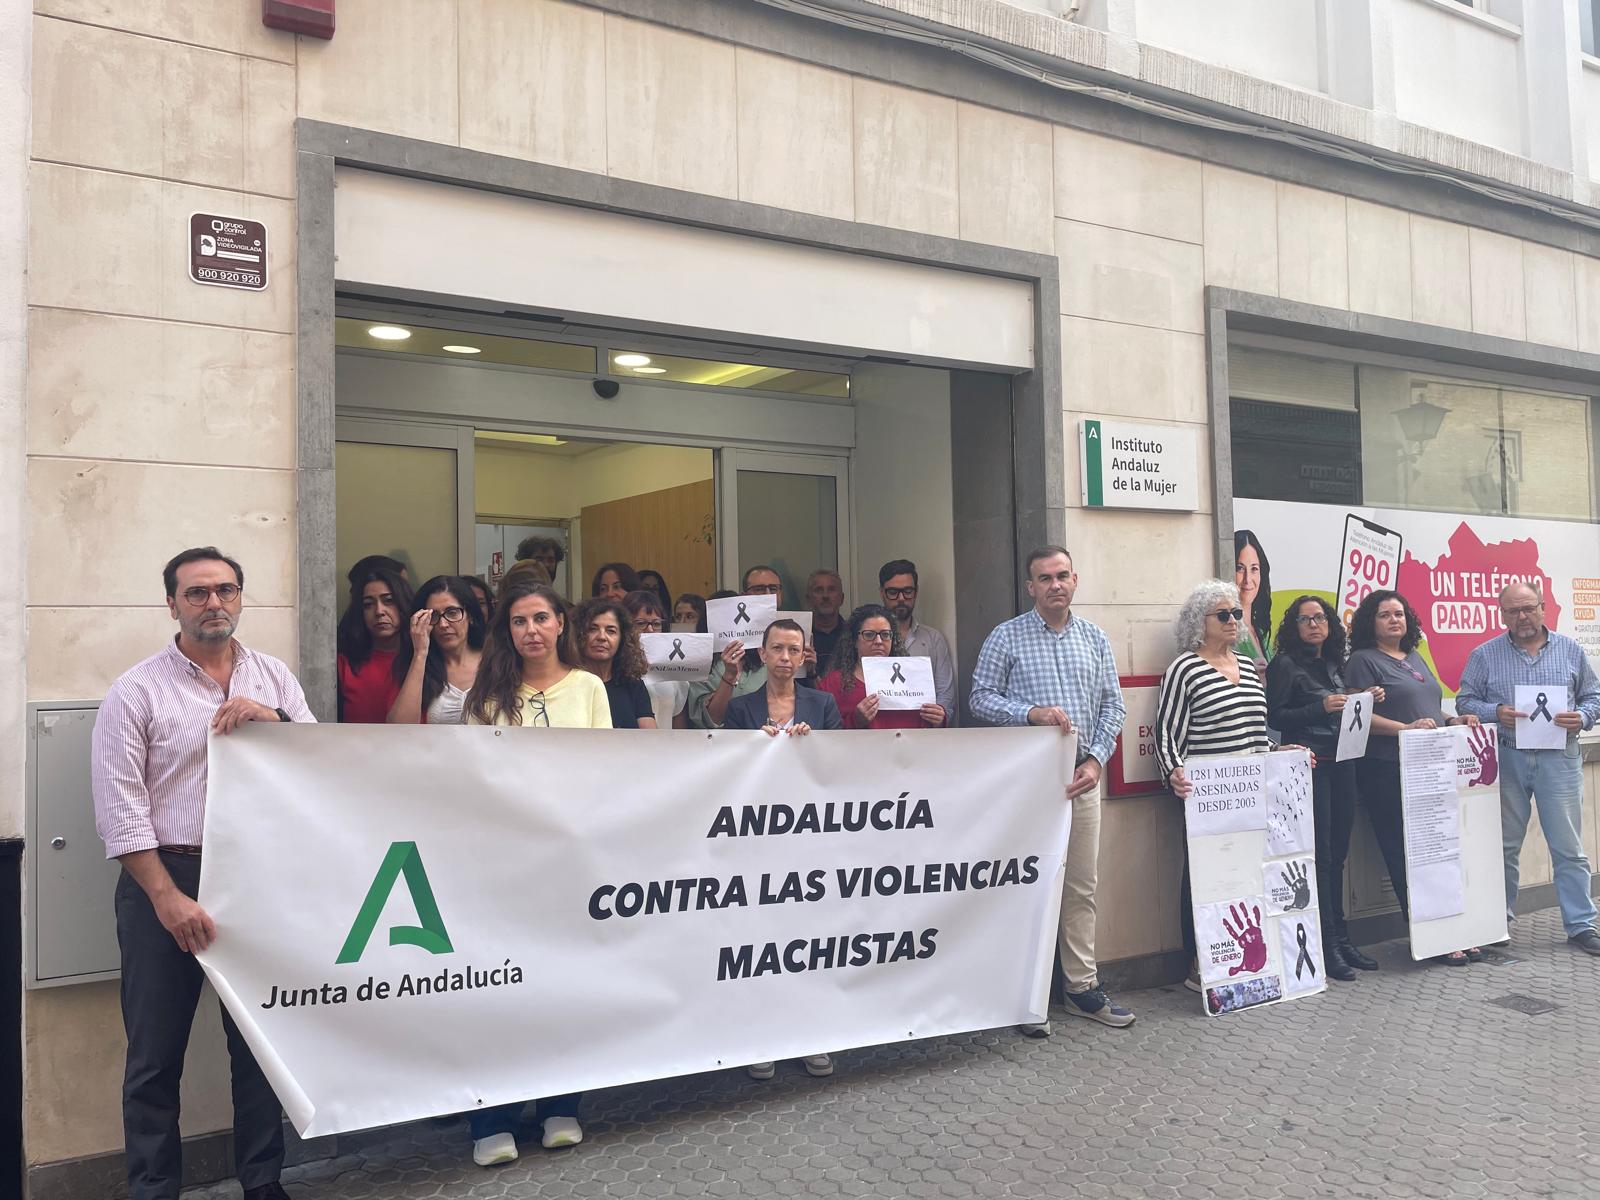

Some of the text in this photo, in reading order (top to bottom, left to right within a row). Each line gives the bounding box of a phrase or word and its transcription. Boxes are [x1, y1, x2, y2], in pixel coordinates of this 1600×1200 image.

[224, 227, 246, 235] control
[217, 242, 262, 252] VIDEOVIGILADA
[198, 269, 260, 283] 900 920 920
[1111, 437, 1162, 453] Instituto
[1112, 458, 1160, 472] Andaluz
[1113, 477, 1176, 495] de la Mujer
[1350, 549, 1389, 586] 900
[1430, 571, 1455, 597] UN
[1437, 604, 1484, 629] PARA
[1575, 609, 1594, 619] AYUDA
[1190, 764, 1261, 781] 1281 MUJERES
[1193, 780, 1259, 797] ASESINADAS
[1198, 797, 1256, 813] DESDE 2003
[706, 792, 934, 838] ANDALUCÍA
[587, 855, 1040, 921] CONTRA LAS VIOLENCIAS
[716, 928, 939, 981] MACHISTAS
[1210, 943, 1220, 951] NO
[1211, 948, 1235, 956] VIOLENCIA
[261, 958, 523, 1009] Junta de Andalucía
